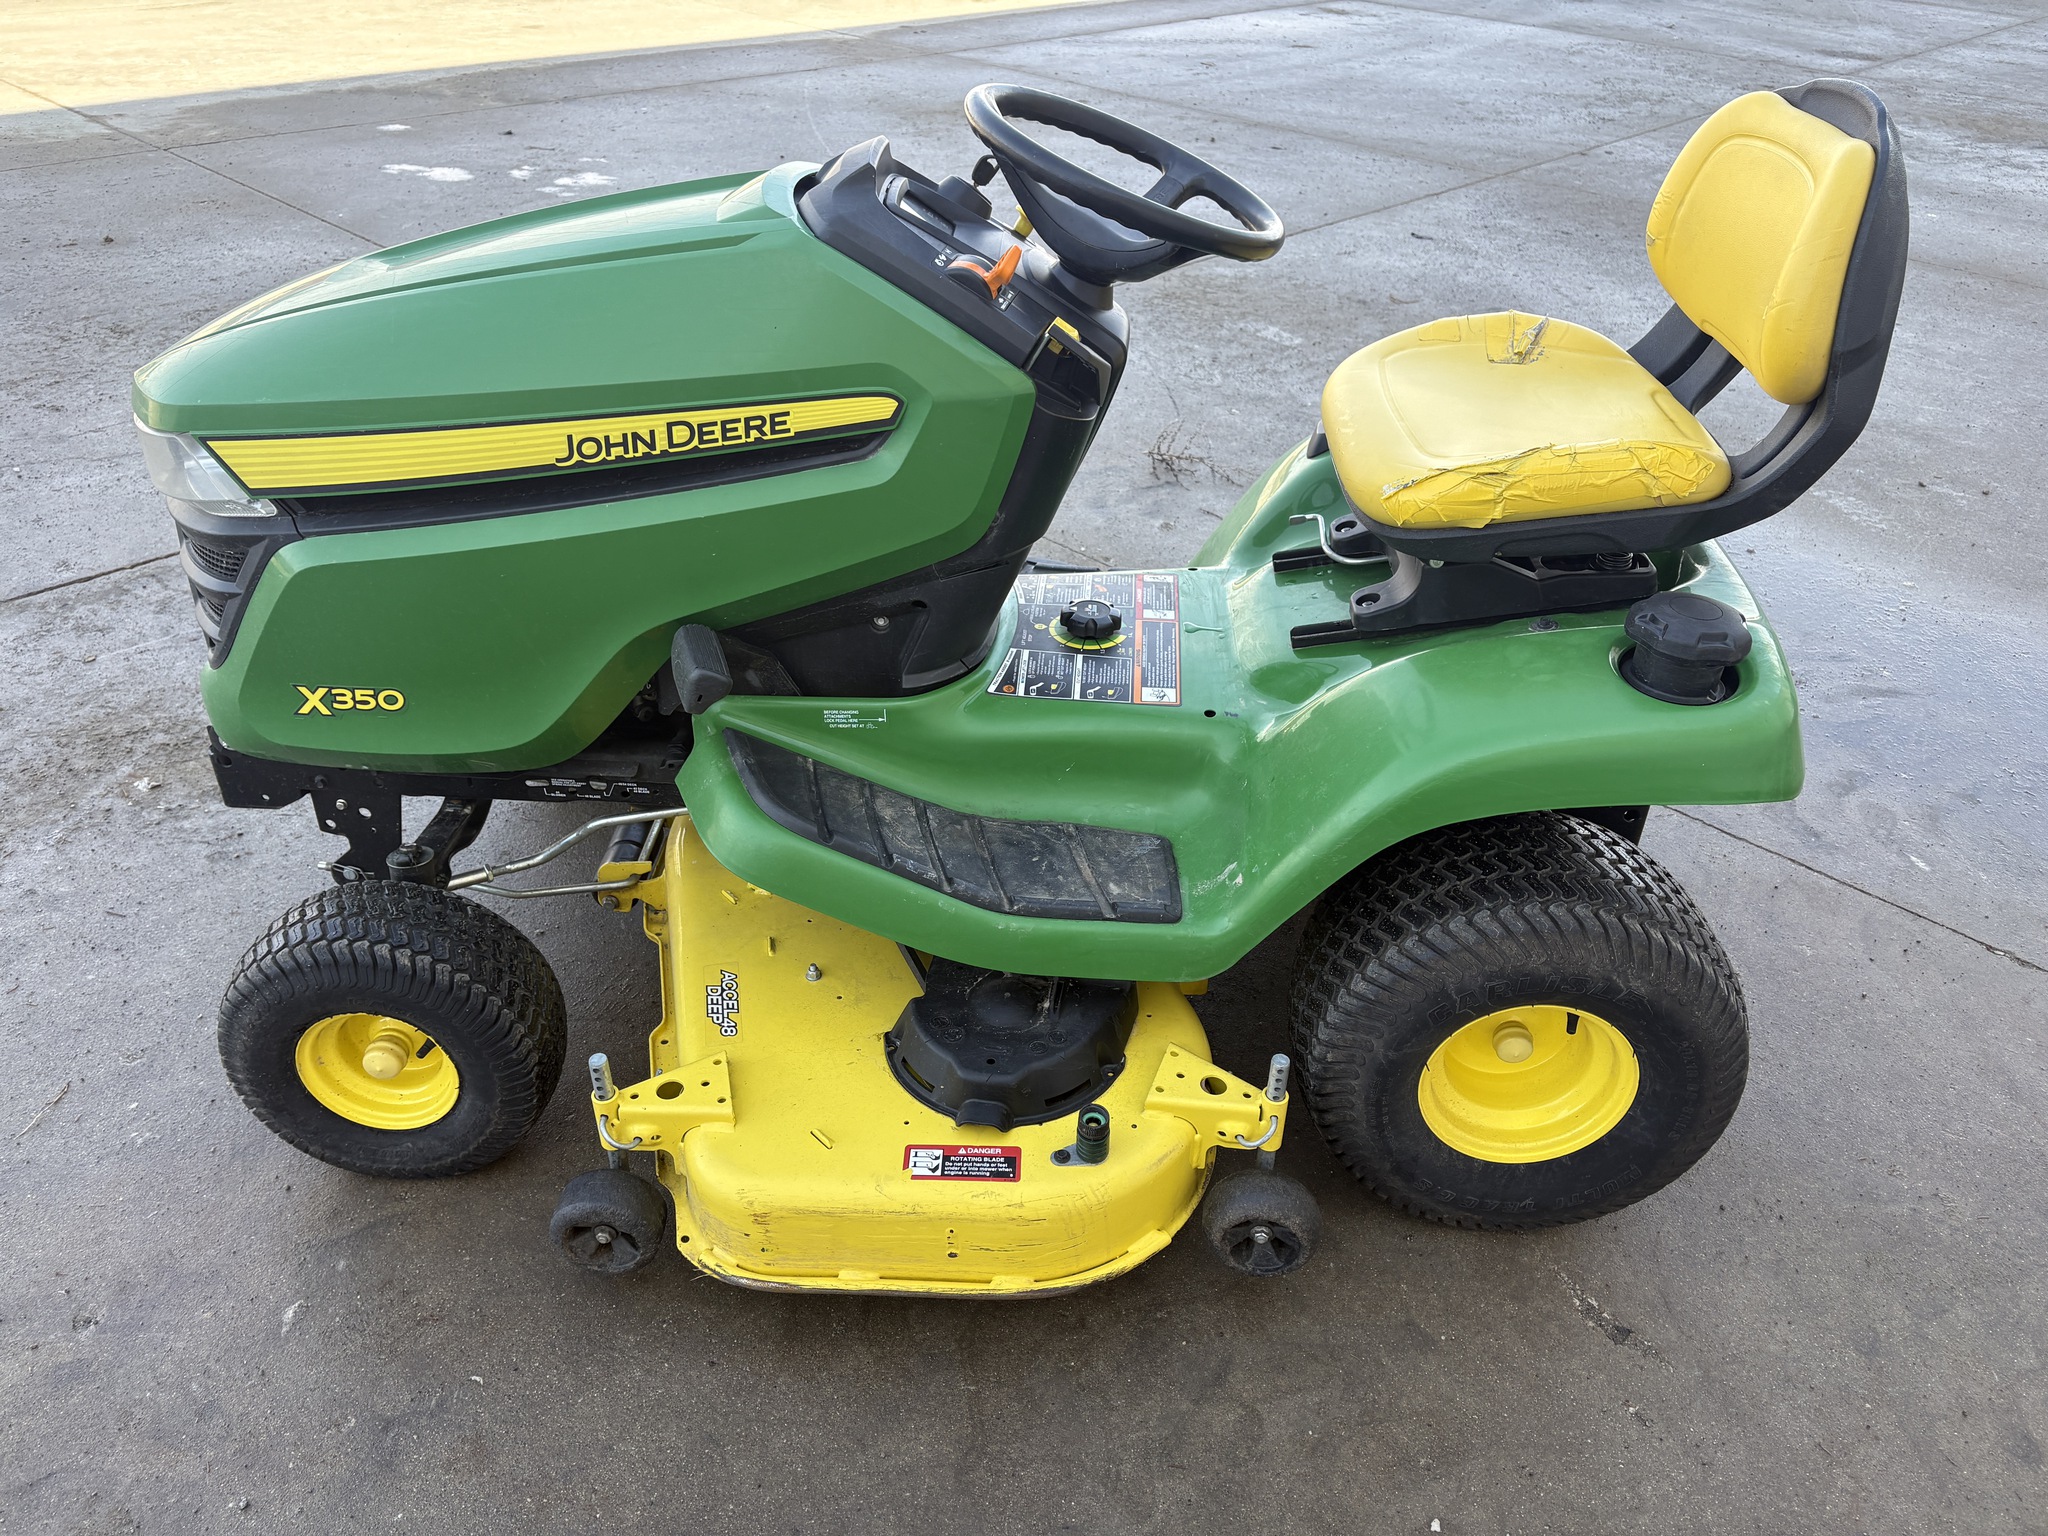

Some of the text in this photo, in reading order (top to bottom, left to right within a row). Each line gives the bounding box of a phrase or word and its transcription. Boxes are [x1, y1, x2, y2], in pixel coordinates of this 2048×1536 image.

[554, 410, 791, 464] JOHN DEERE
[291, 685, 405, 717] X350
[706, 985, 723, 1026] DEEP
[1427, 975, 1653, 1026] CARLISLE
[967, 1147, 1002, 1155] DANGER
